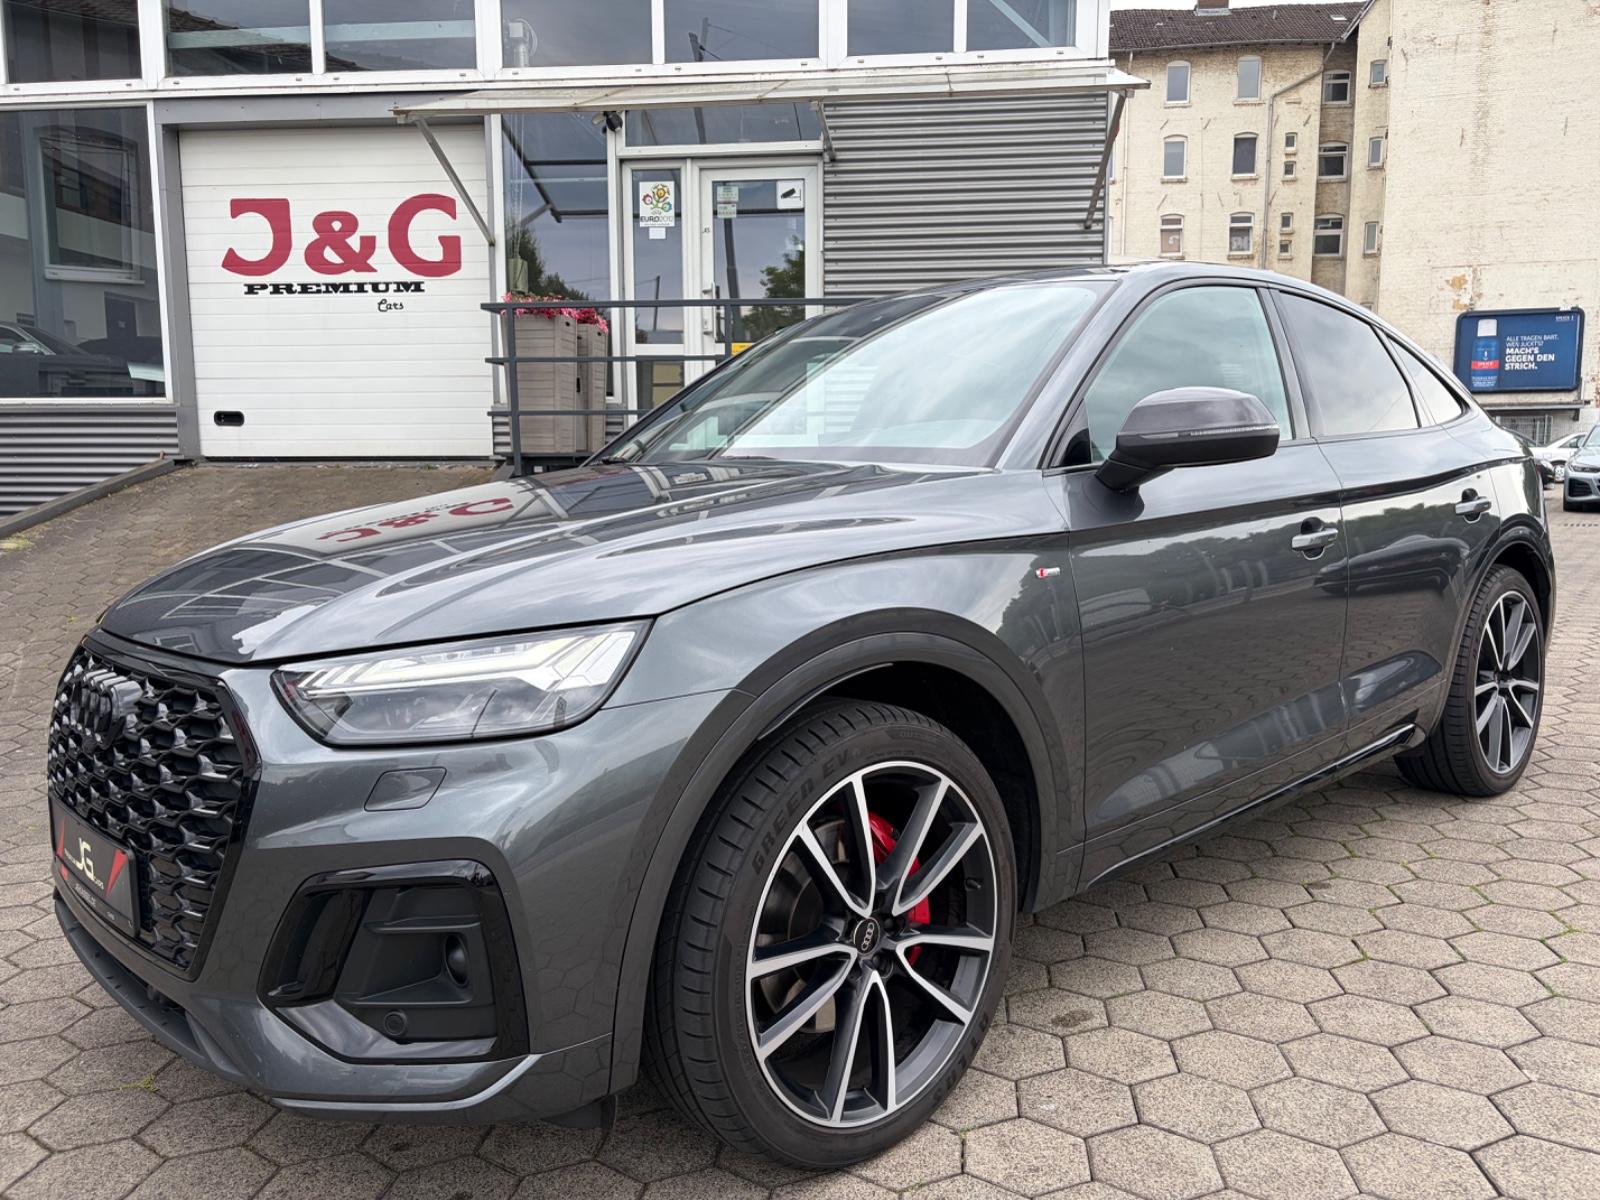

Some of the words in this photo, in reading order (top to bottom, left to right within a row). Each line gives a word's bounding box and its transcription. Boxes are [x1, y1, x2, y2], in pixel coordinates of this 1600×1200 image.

[221, 193, 462, 278] J&G
[243, 281, 426, 296] PREMIUM
[377, 299, 405, 312] Cars
[1505, 354, 1534, 362] GEGEN
[1536, 353, 1555, 361] DEN
[1504, 362, 1538, 371] STRICH.
[752, 777, 815, 875] GREEN
[822, 749, 849, 778] EV
